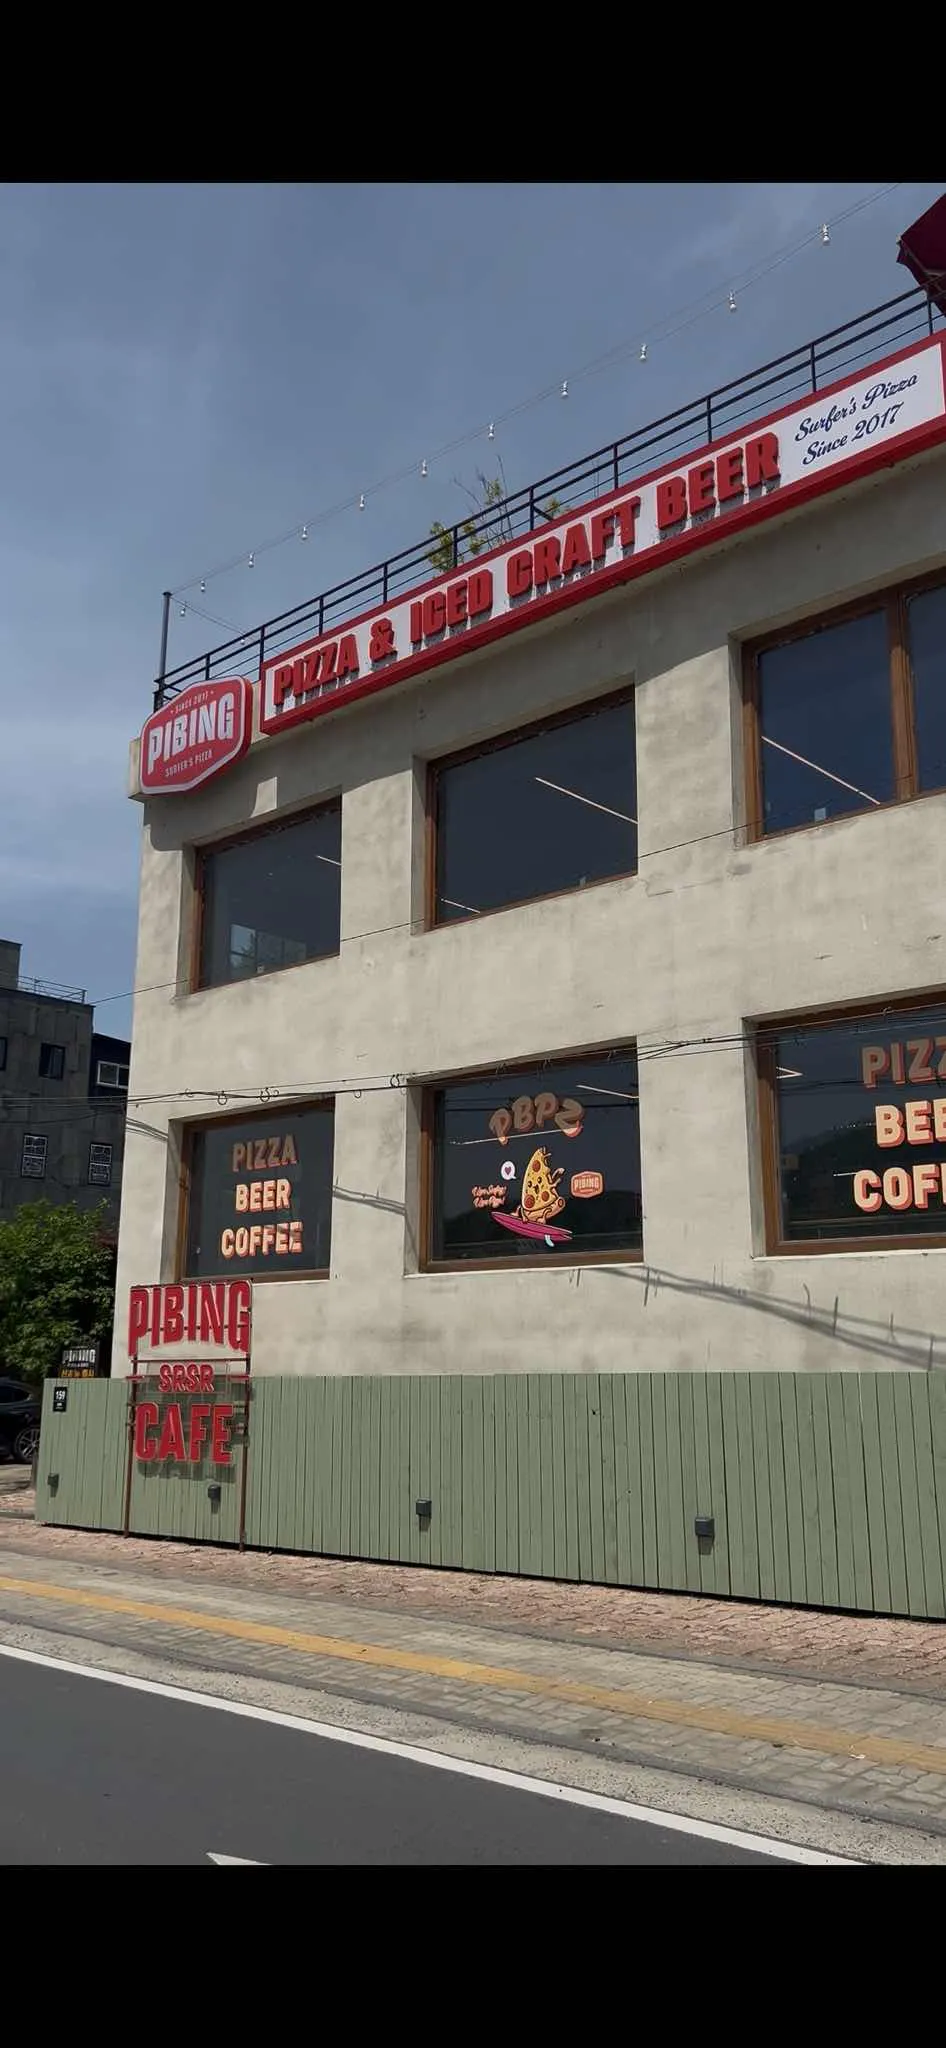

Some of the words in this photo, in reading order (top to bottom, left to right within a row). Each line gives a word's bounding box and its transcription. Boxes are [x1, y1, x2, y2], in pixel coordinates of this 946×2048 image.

[794, 397, 857, 442] Surfer's
[861, 374, 918, 410] Pizza
[802, 434, 848, 465] Since
[851, 401, 905, 442] 2017
[273, 633, 359, 706] PIZZA
[369, 617, 397, 662] &
[410, 568, 493, 643] ICED
[506, 496, 641, 598] CRAFT
[656, 431, 781, 530] BEER
[147, 692, 234, 775] PIBING
[165, 758, 194, 777] SURFER'S
[195, 749, 213, 765] PIZZA
[232, 1133, 298, 1172] PIZZA
[235, 1178, 292, 1213] BEER
[854, 1163, 946, 1212] COF
[221, 1220, 304, 1258] COFFEE
[128, 1280, 252, 1357] PIBING
[159, 1363, 215, 1392] SRSR
[135, 1402, 234, 1465] CAFE
